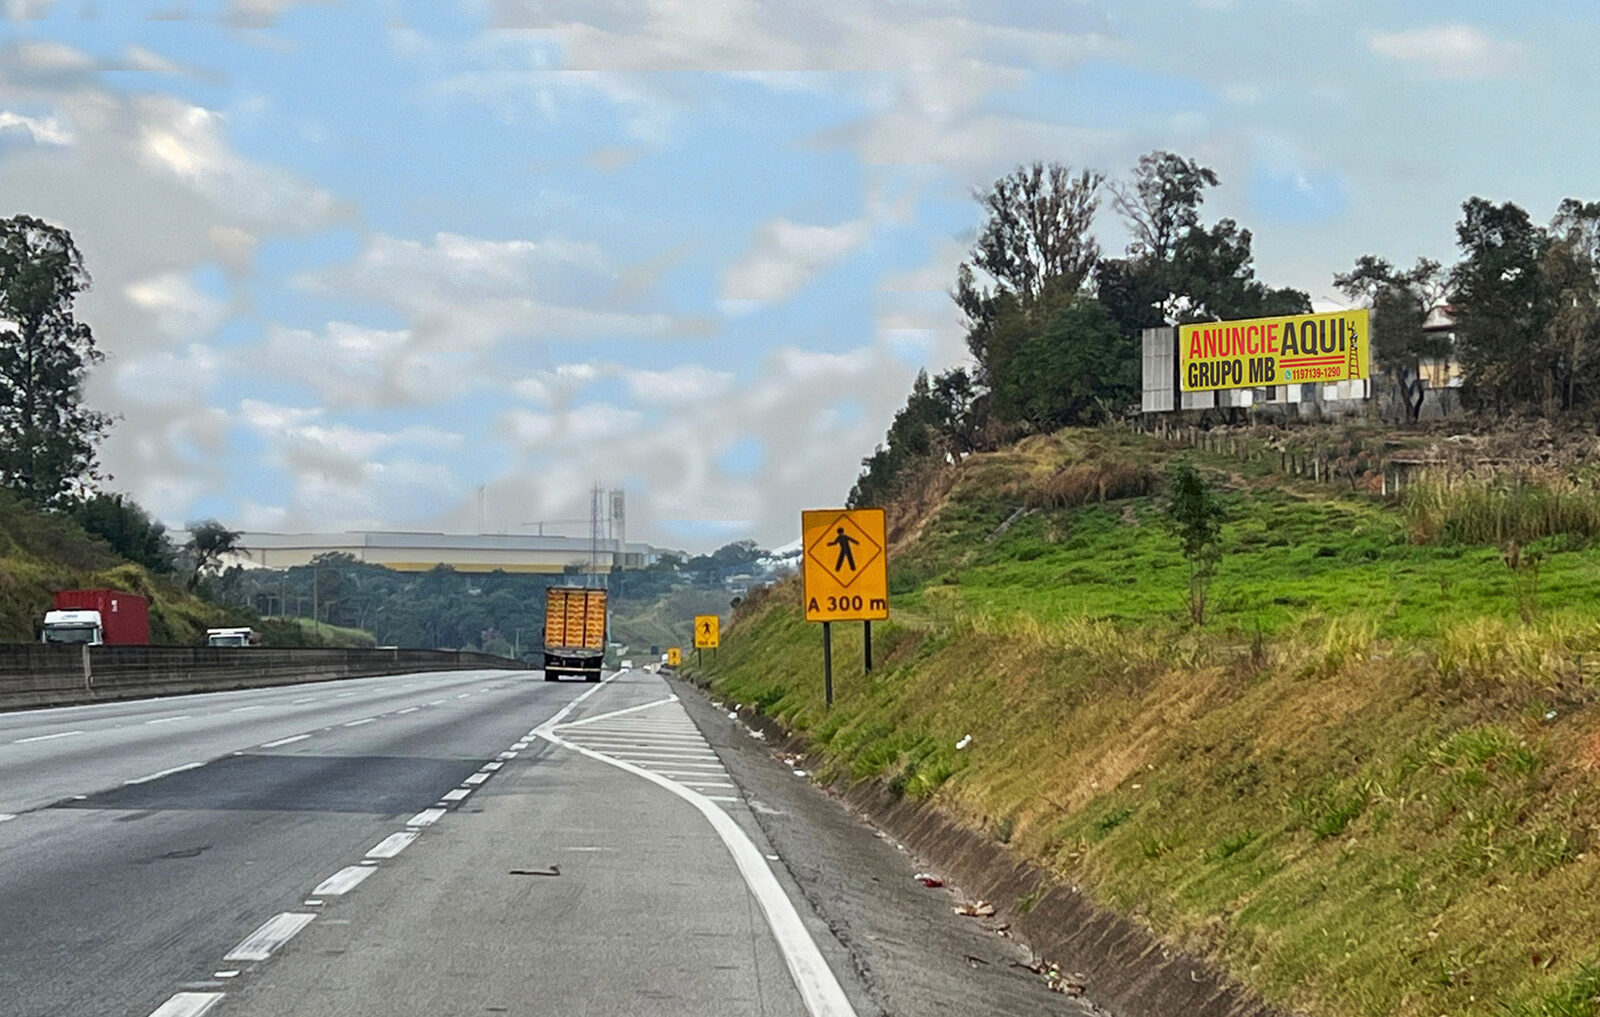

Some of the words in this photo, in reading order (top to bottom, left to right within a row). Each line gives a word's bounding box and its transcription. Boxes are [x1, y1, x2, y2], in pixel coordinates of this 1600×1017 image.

[1189, 324, 1279, 359] ANUNCIE
[1280, 318, 1345, 356] AQUI
[1188, 359, 1242, 388] GRUPO
[1249, 357, 1275, 384] MB
[808, 597, 820, 612] A
[827, 596, 863, 612] 300
[870, 598, 886, 610] m
